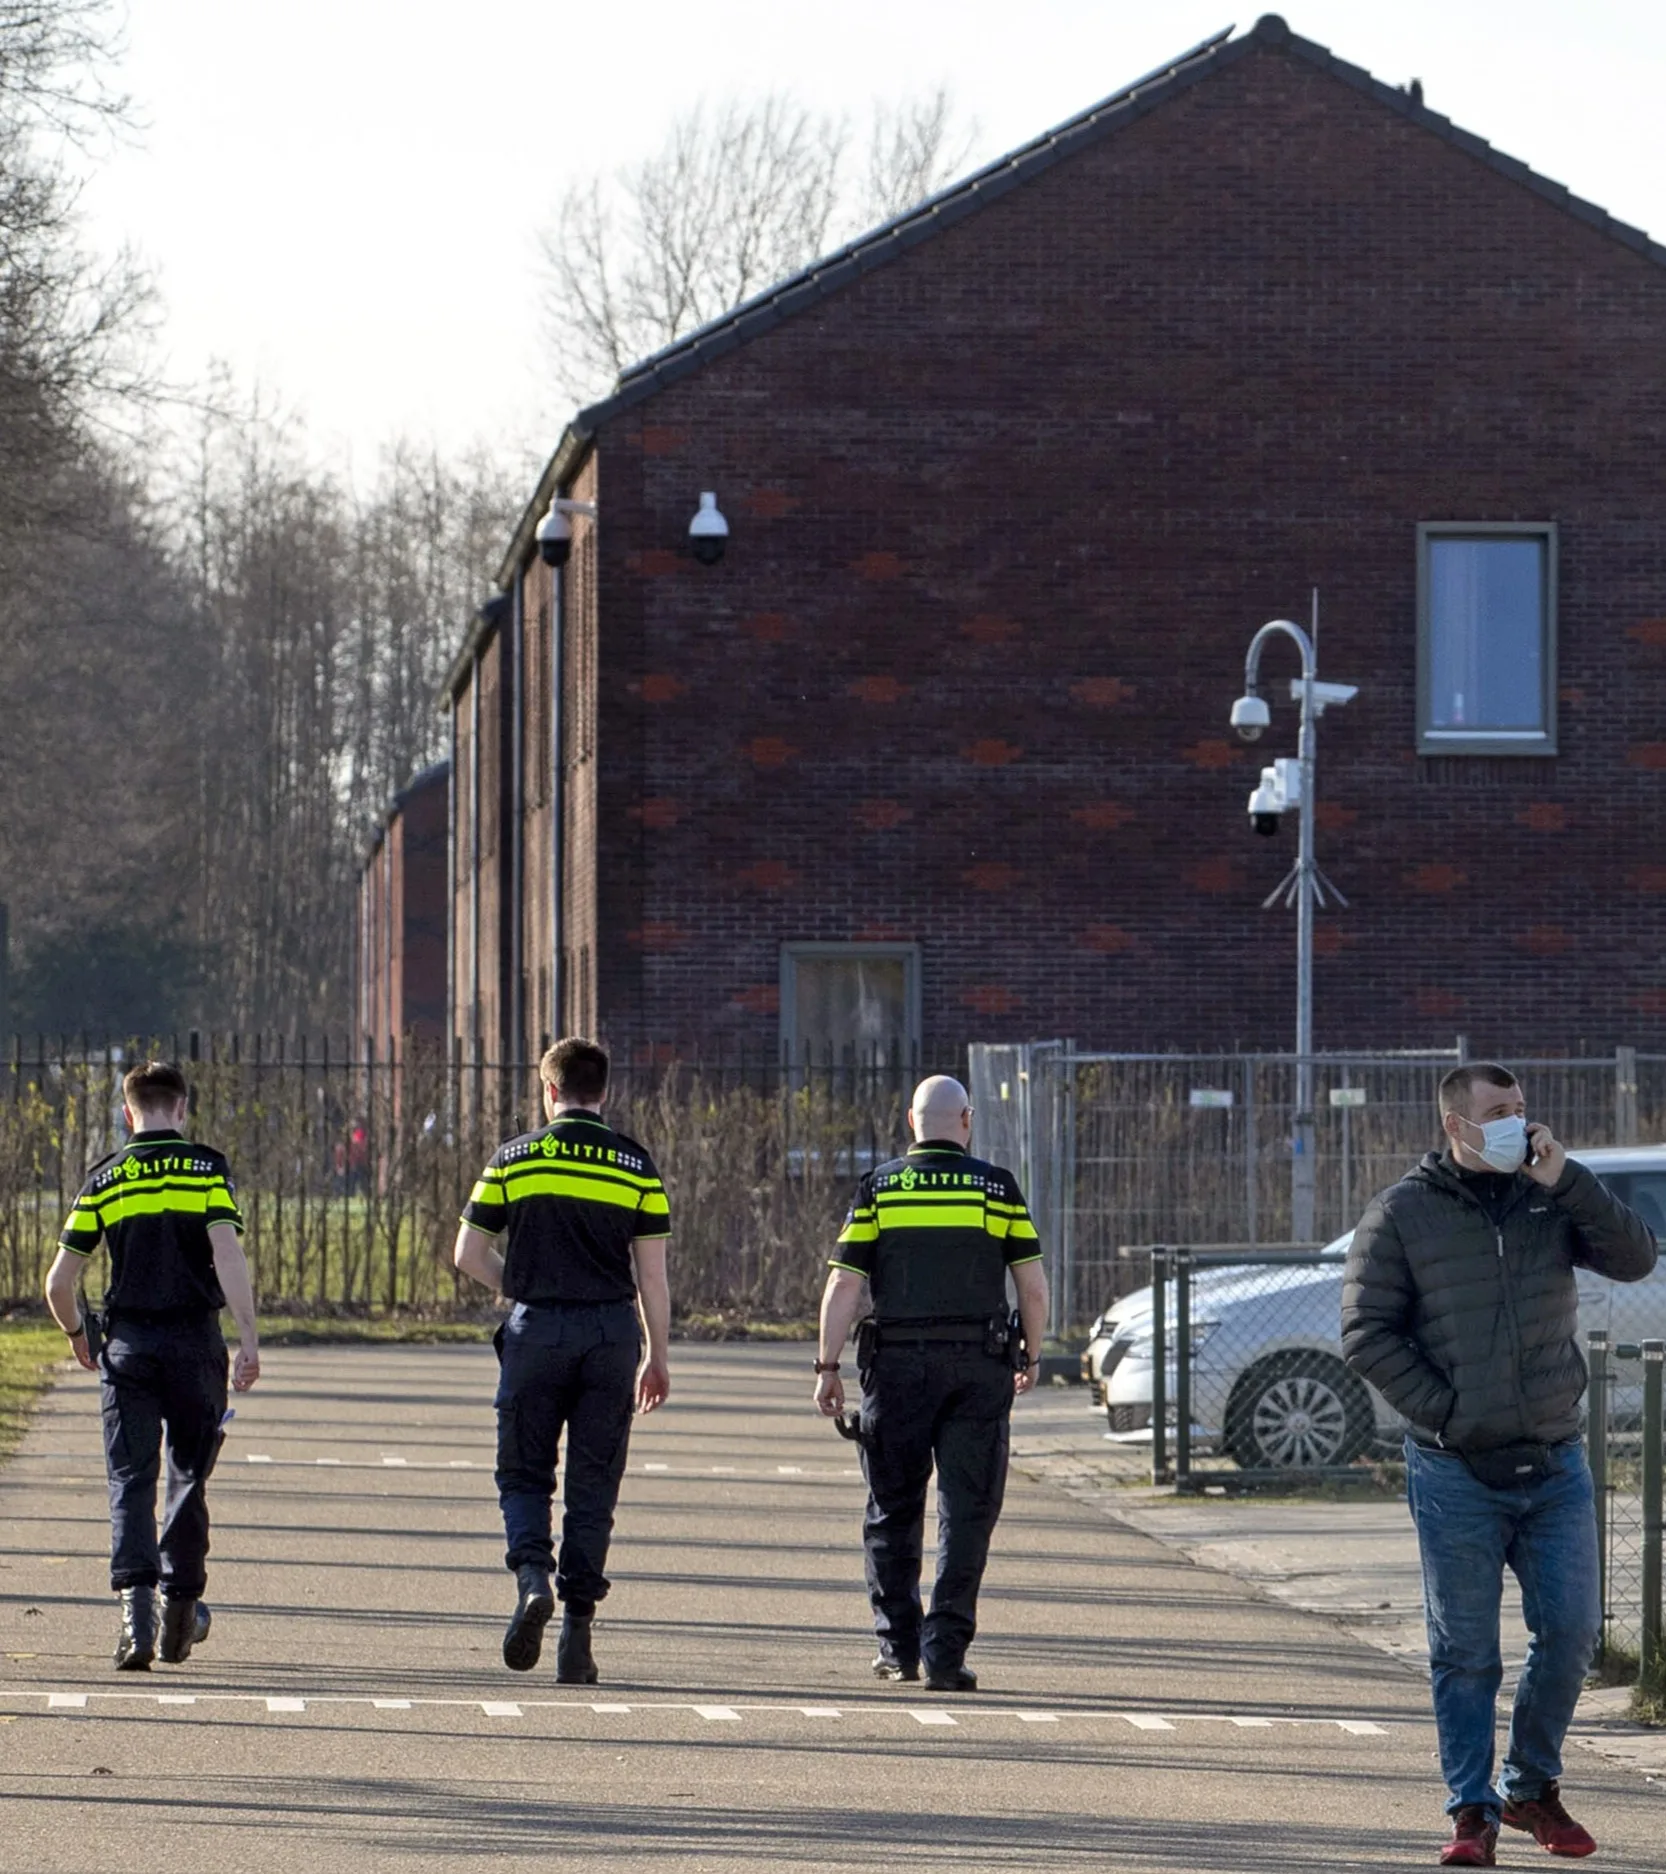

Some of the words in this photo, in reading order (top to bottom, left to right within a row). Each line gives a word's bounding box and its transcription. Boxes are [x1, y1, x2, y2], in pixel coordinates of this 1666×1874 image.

[529, 1133, 618, 1162] POLITIE
[113, 1156, 193, 1180] POLITIE
[889, 1166, 973, 1190] POLITIE
